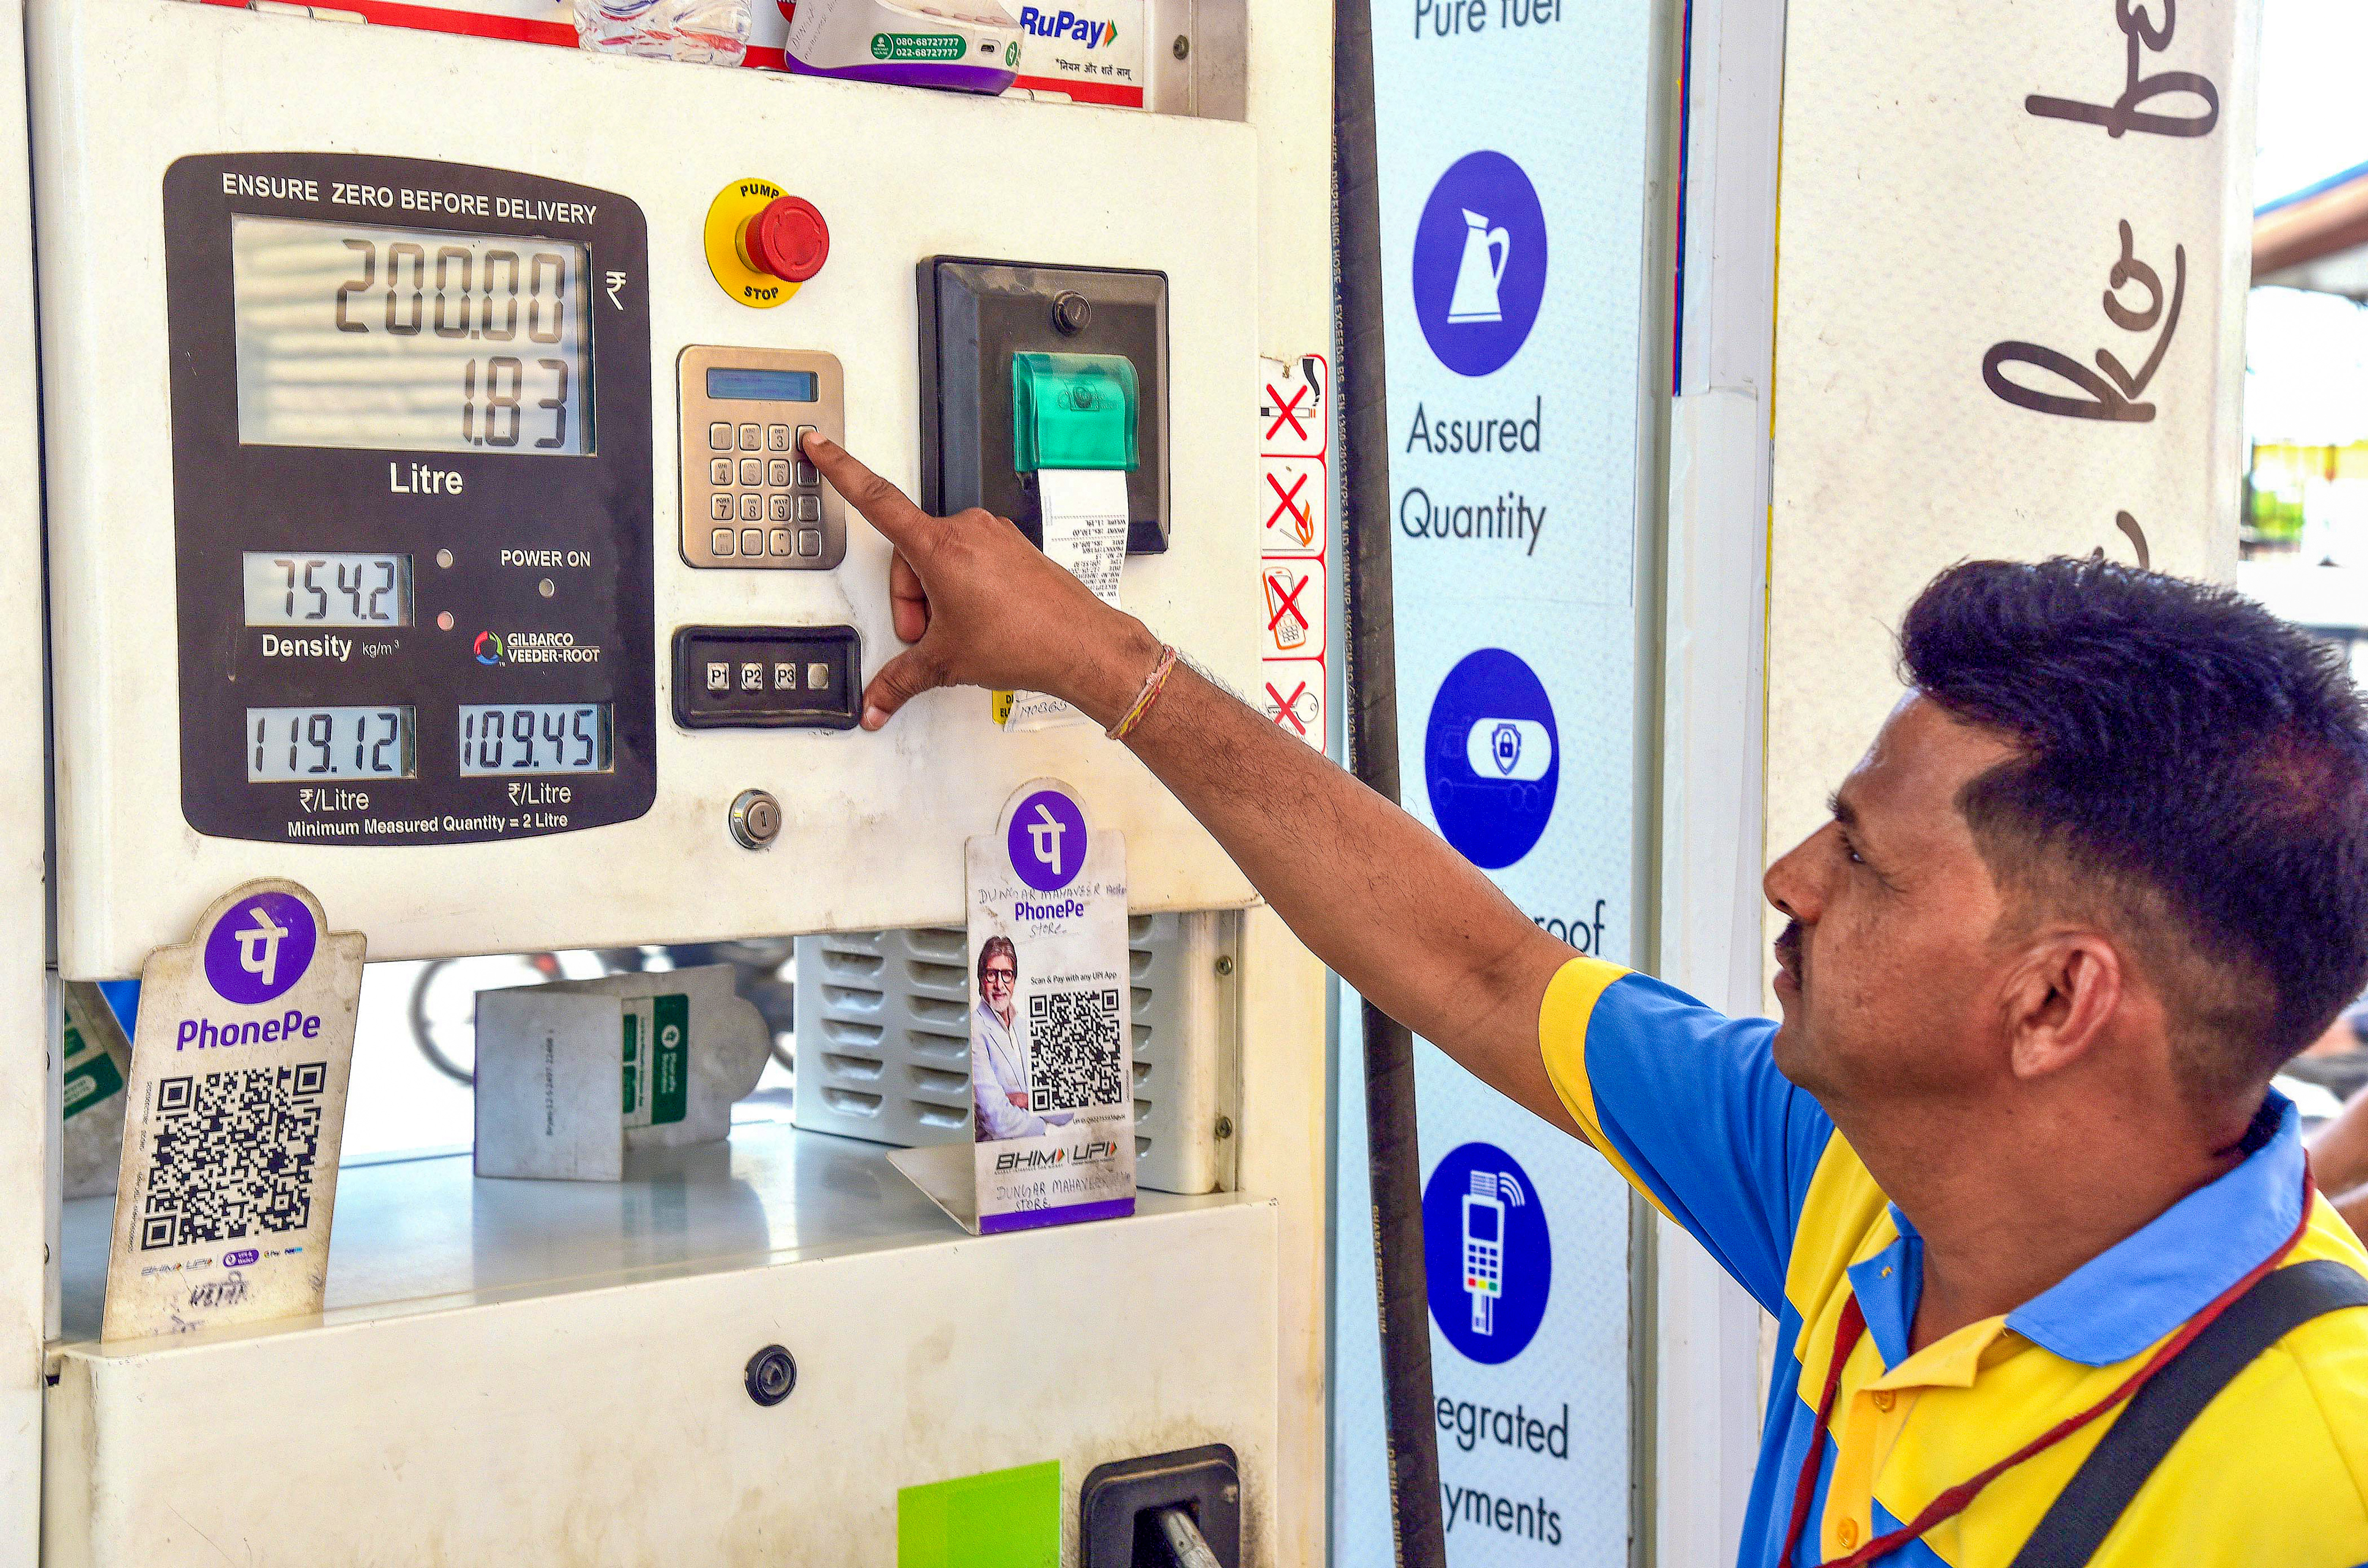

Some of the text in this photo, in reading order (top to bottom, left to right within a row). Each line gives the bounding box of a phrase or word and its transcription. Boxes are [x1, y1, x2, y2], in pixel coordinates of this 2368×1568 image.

[1020, 6, 1105, 49] RuPay
[1414, 0, 1486, 39] Pure
[896, 37, 959, 47] 080-68727777
[896, 48, 958, 57] 022-68727777
[222, 172, 597, 225] ENSURE ZERO BEFORE DELIVERY
[740, 184, 779, 199] PUMP
[1333, 250, 1341, 283] HOSE
[336, 238, 565, 343] 200.00
[744, 285, 779, 300] STOP
[1335, 305, 1344, 363] EXCEEDS
[463, 356, 569, 448] 1.83
[1407, 395, 1541, 453] Assured
[777, 435, 784, 448] 3
[390, 462, 464, 495] Litre
[719, 470, 727, 483] 4
[777, 470, 784, 483] 6
[719, 505, 727, 517] 7
[749, 506, 756, 517] 8
[778, 506, 785, 518] 9
[1400, 487, 1547, 556] Quantity
[500, 550, 591, 567] POWER ON
[274, 558, 394, 619] 754.2
[262, 634, 352, 662] Density
[507, 633, 574, 647] GILBARCO
[507, 648, 600, 664] VEEDER-ROOT
[712, 671, 727, 683] P1
[744, 671, 761, 683] P2
[778, 671, 794, 683] P3
[255, 713, 397, 772] 119.12
[463, 710, 594, 768] 109.45
[299, 788, 370, 813] ₹/Litre
[508, 782, 571, 807] ₹/Litre
[288, 813, 568, 838] Minimum Measured Quantity = 2 Litre
[1015, 899, 1084, 921] PhonePe
[1030, 971, 1117, 985] Scan & Pay with any UPI App
[177, 1009, 321, 1051] PhonePe
[997, 1141, 1110, 1170] BHIM UPI
[1440, 1483, 1563, 1546] yments
